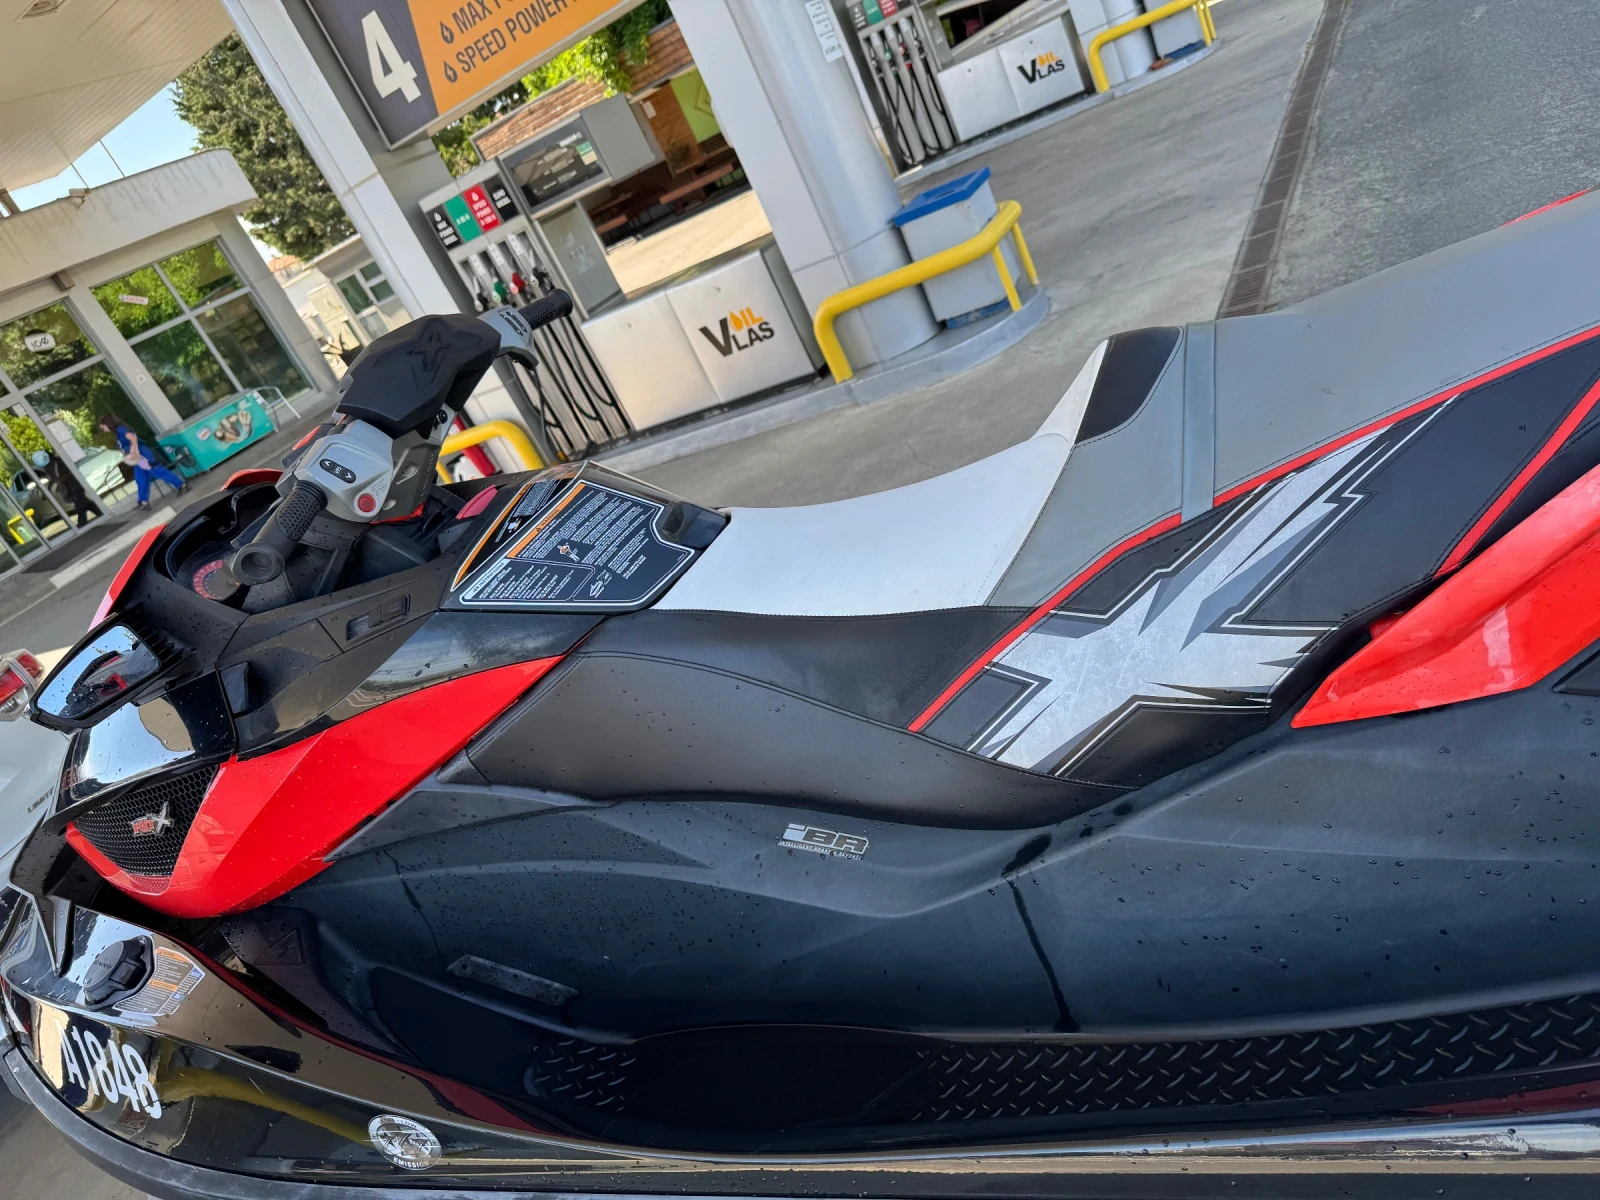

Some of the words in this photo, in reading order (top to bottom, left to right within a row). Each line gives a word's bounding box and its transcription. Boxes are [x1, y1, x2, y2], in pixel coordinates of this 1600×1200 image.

[452, 0, 493, 34] MAX
[361, 10, 421, 104] 4
[456, 28, 506, 73] SPEED
[1017, 58, 1065, 84] VLAS
[699, 317, 775, 357] VLAS
[540, 508, 560, 527] WARNING
[54, 1018, 162, 1119] A1848
[393, 1157, 430, 1168] EMISSION
